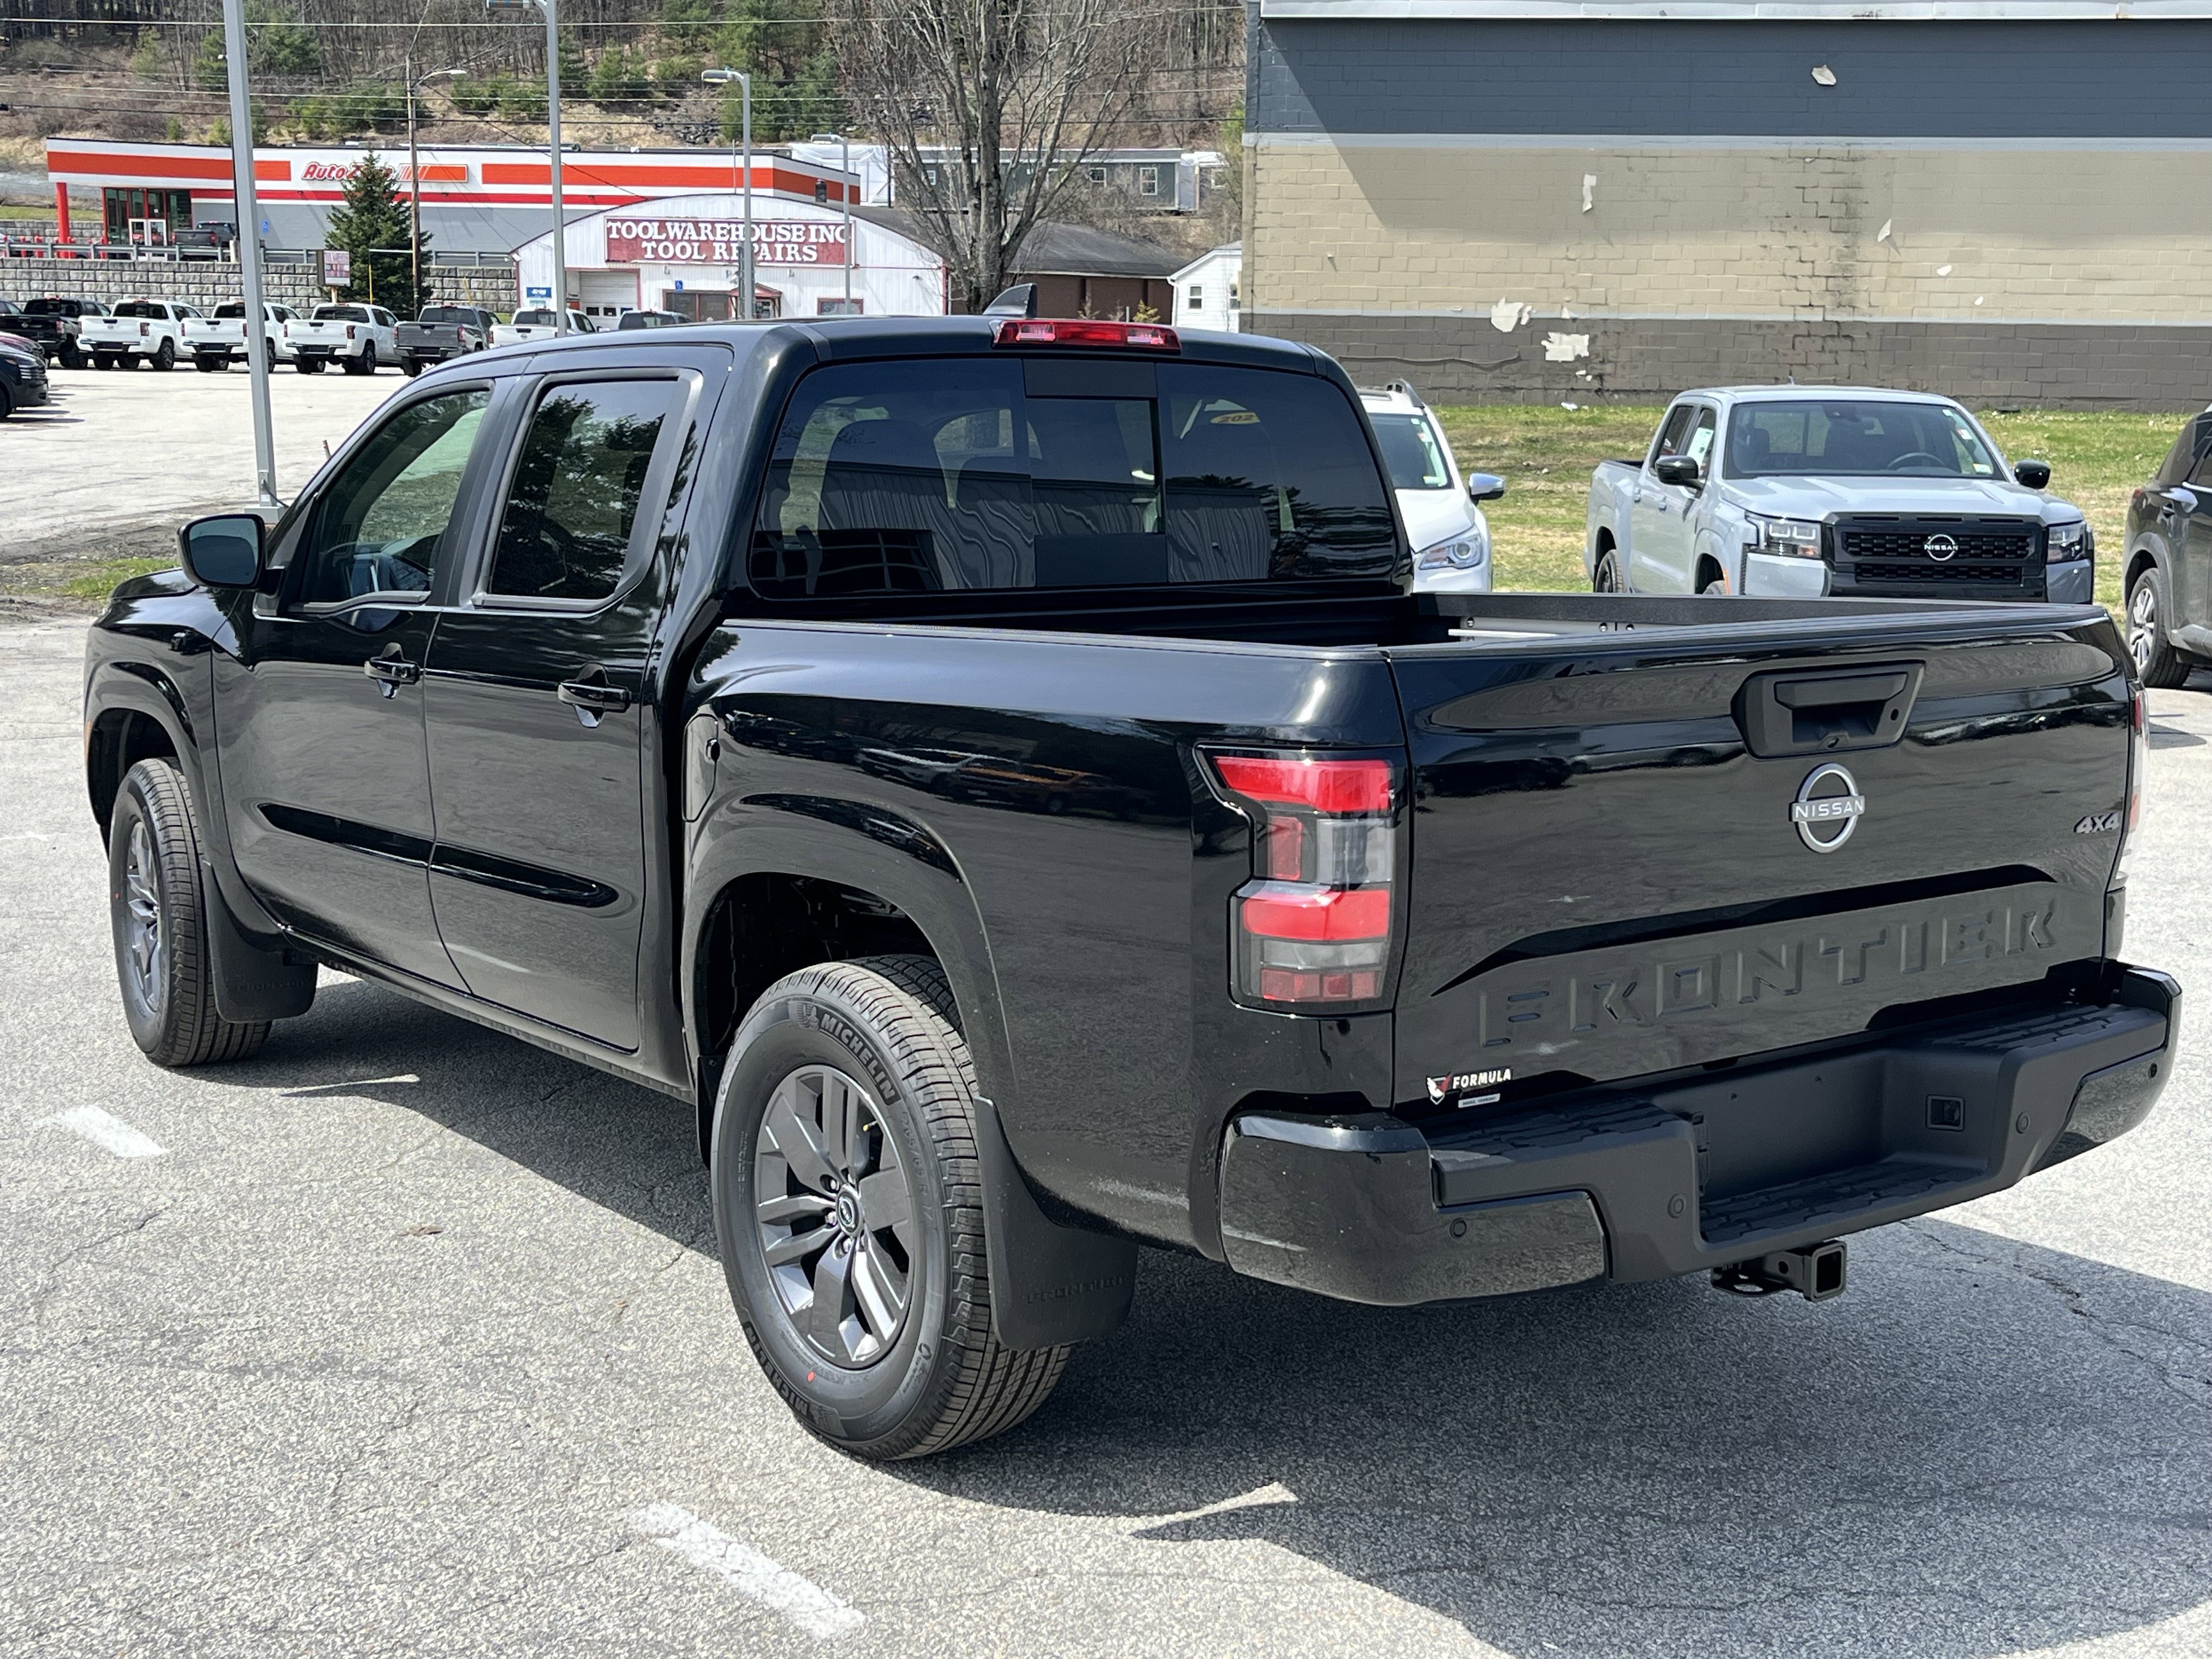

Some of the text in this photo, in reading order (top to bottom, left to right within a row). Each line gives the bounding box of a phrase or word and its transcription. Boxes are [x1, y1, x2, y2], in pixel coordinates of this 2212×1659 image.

[808, 224, 851, 244] INC
[641, 241, 707, 259] TOOL
[1795, 800, 1864, 819] NISSAN
[1480, 898, 2056, 1048] FRONTIER
[820, 1013, 895, 1099] MICHELIN
[1452, 1068, 1511, 1089] FORMULA
[745, 1327, 808, 1417] MICHELIN
